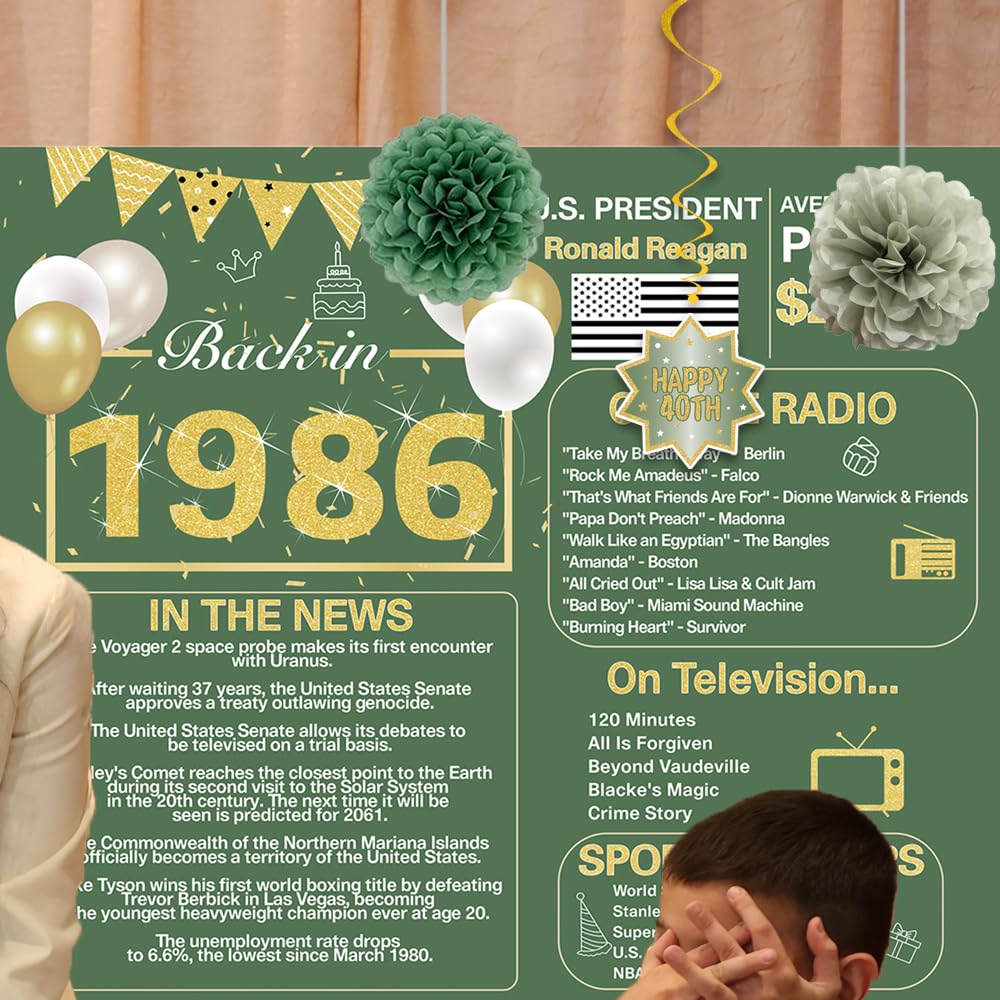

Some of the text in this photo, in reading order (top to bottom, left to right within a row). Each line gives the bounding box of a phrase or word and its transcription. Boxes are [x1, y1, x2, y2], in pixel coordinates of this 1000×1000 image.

[595, 196, 763, 221] PRESIDENT
[544, 236, 748, 265] Ronald Reagan
[157, 319, 390, 371] Back in
[651, 366, 728, 395] HAPPY
[659, 394, 722, 422] 40TH
[772, 391, 897, 425] RADIO
[562, 446, 603, 461] "Take
[606, 446, 634, 464] My
[744, 446, 785, 461] Berlin
[69, 409, 495, 541] 1986
[563, 467, 759, 481] "Rock Me Amadeus" Falco
[563, 489, 968, 503] "That's What Friends Are For" Dionne Warwick & Friends
[563, 511, 784, 528] "Papa Don't Preach" Madonna
[563, 532, 829, 549] "Walk Like an Egyptian" The Bangles
[563, 554, 698, 568] "Amanda" Boston
[563, 576, 815, 590] "All Cried Out" Lisa Lisa & Cult Jam
[563, 597, 803, 614] "Bad Boy" Miami Sound Machine
[151, 598, 413, 632] IN THE NEWS
[562, 619, 746, 636] "Burning Heart" Survivor
[102, 638, 493, 656] Voyager 2 space probe makes its first encounter
[232, 652, 332, 667] with Uranus.
[608, 662, 898, 694] On Television...
[129, 680, 187, 698] waiting
[192, 680, 211, 695] 37
[216, 684, 265, 698] years,
[270, 680, 296, 695] the
[301, 680, 353, 695] United
[358, 680, 410, 695] States
[415, 680, 471, 695] Senate
[126, 694, 434, 712] approves a treaty outlawing genocide.
[590, 711, 696, 726] 120 Minutes
[588, 735, 712, 753] All Is Forgiven
[589, 758, 749, 776] Beyond Vaudeville
[589, 781, 719, 799] Blacke's Magic
[172, 806, 387, 824] seen is predicted for 2061.
[588, 805, 692, 823] Crime Story
[578, 843, 675, 877] SPO
[613, 884, 657, 897] World
[613, 905, 660, 918] Stanle
[155, 932, 400, 950] The unemployment rate drops
[613, 926, 656, 941] Super
[127, 947, 432, 965] to 6.6%, the lowest since March 1980.
[613, 946, 642, 959] U.S.
